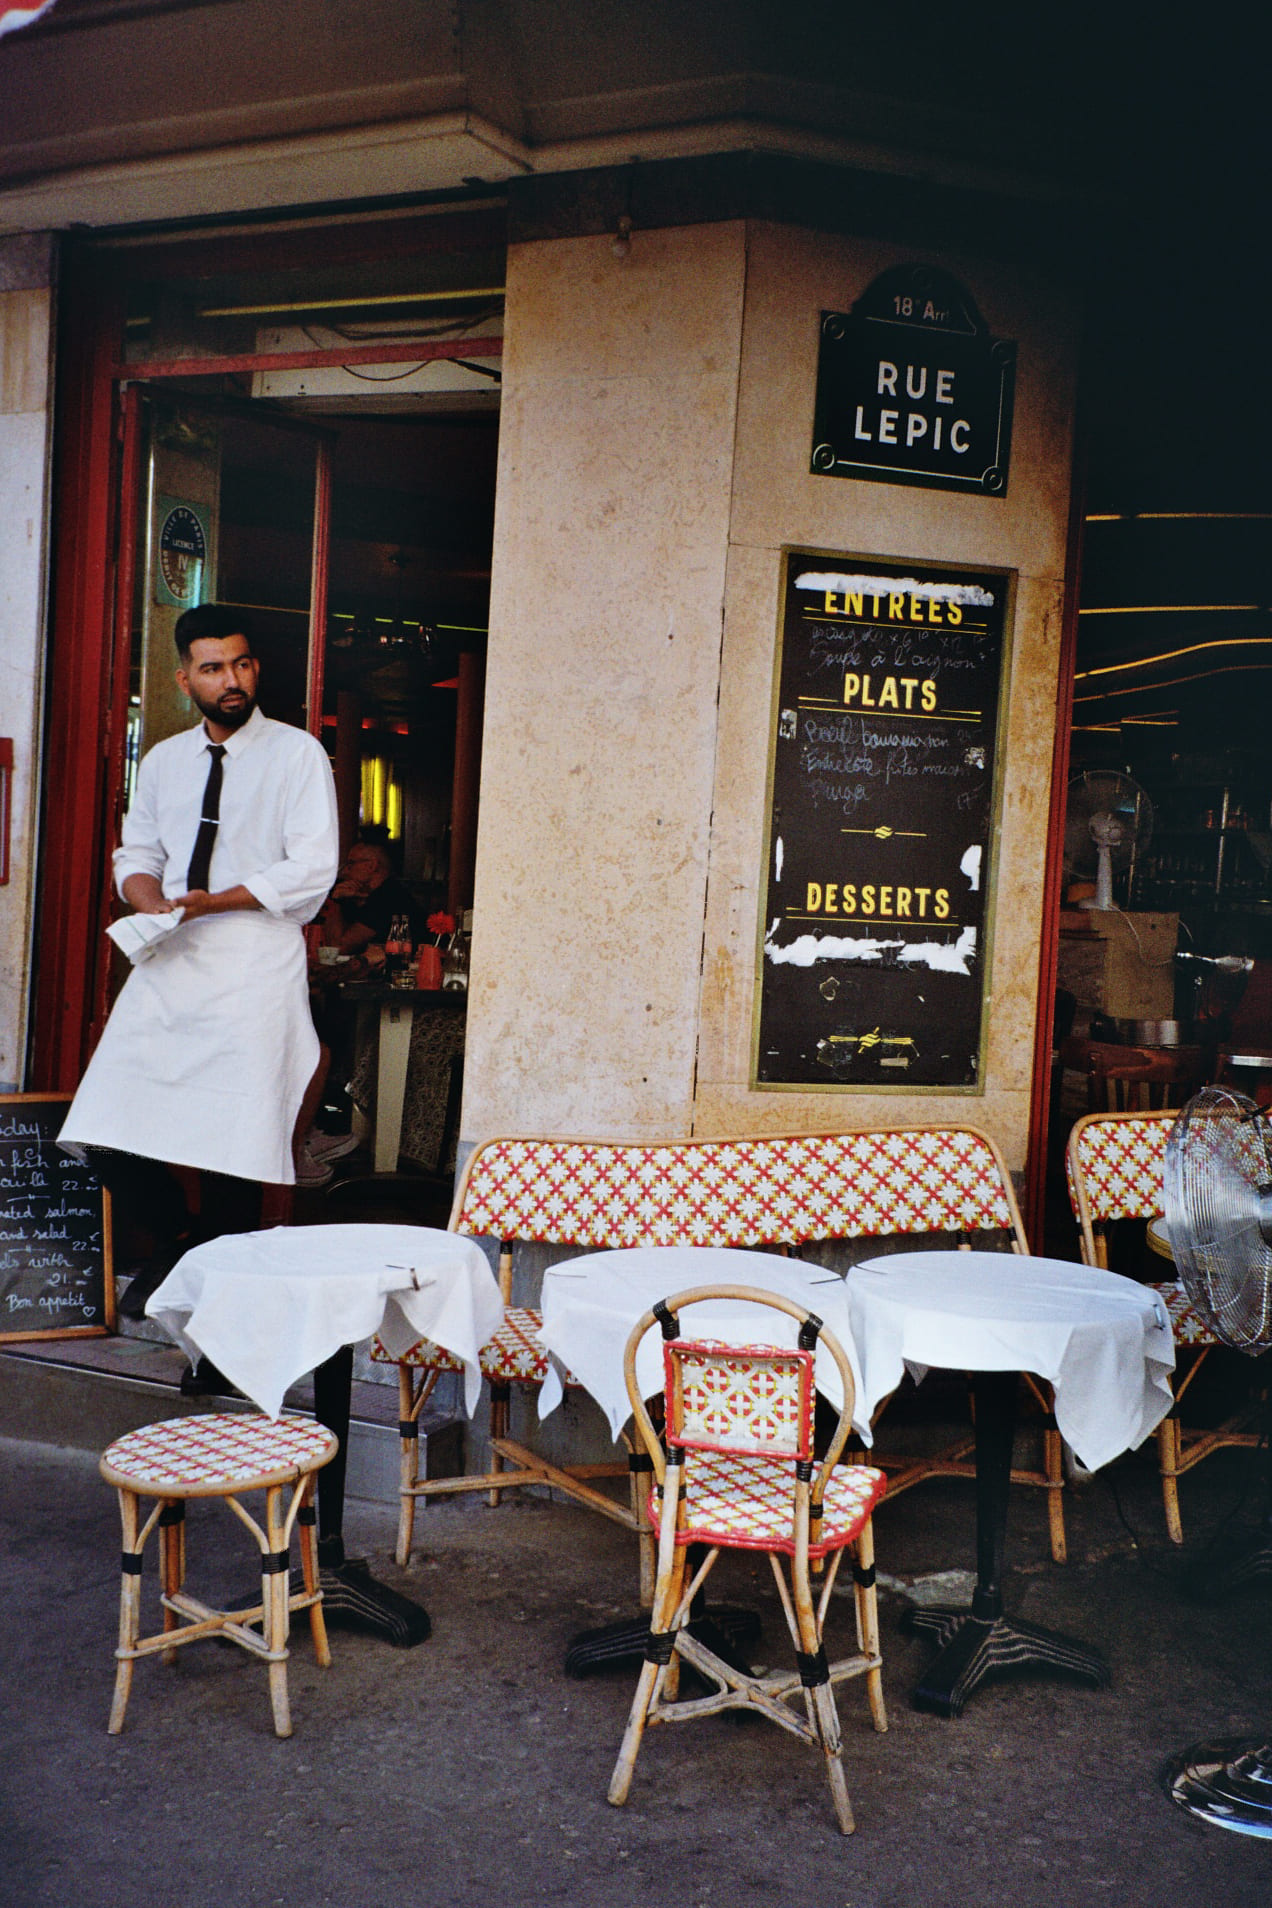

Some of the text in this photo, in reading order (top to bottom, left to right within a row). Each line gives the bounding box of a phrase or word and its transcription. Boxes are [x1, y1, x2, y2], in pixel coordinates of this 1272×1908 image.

[876, 360, 956, 405] RUE
[853, 405, 972, 454] LEPIC
[843, 672, 938, 713] PLATS
[806, 882, 950, 919] DESSERTS
[28, 1252, 74, 1268] with
[5, 1293, 34, 1313] Bon
